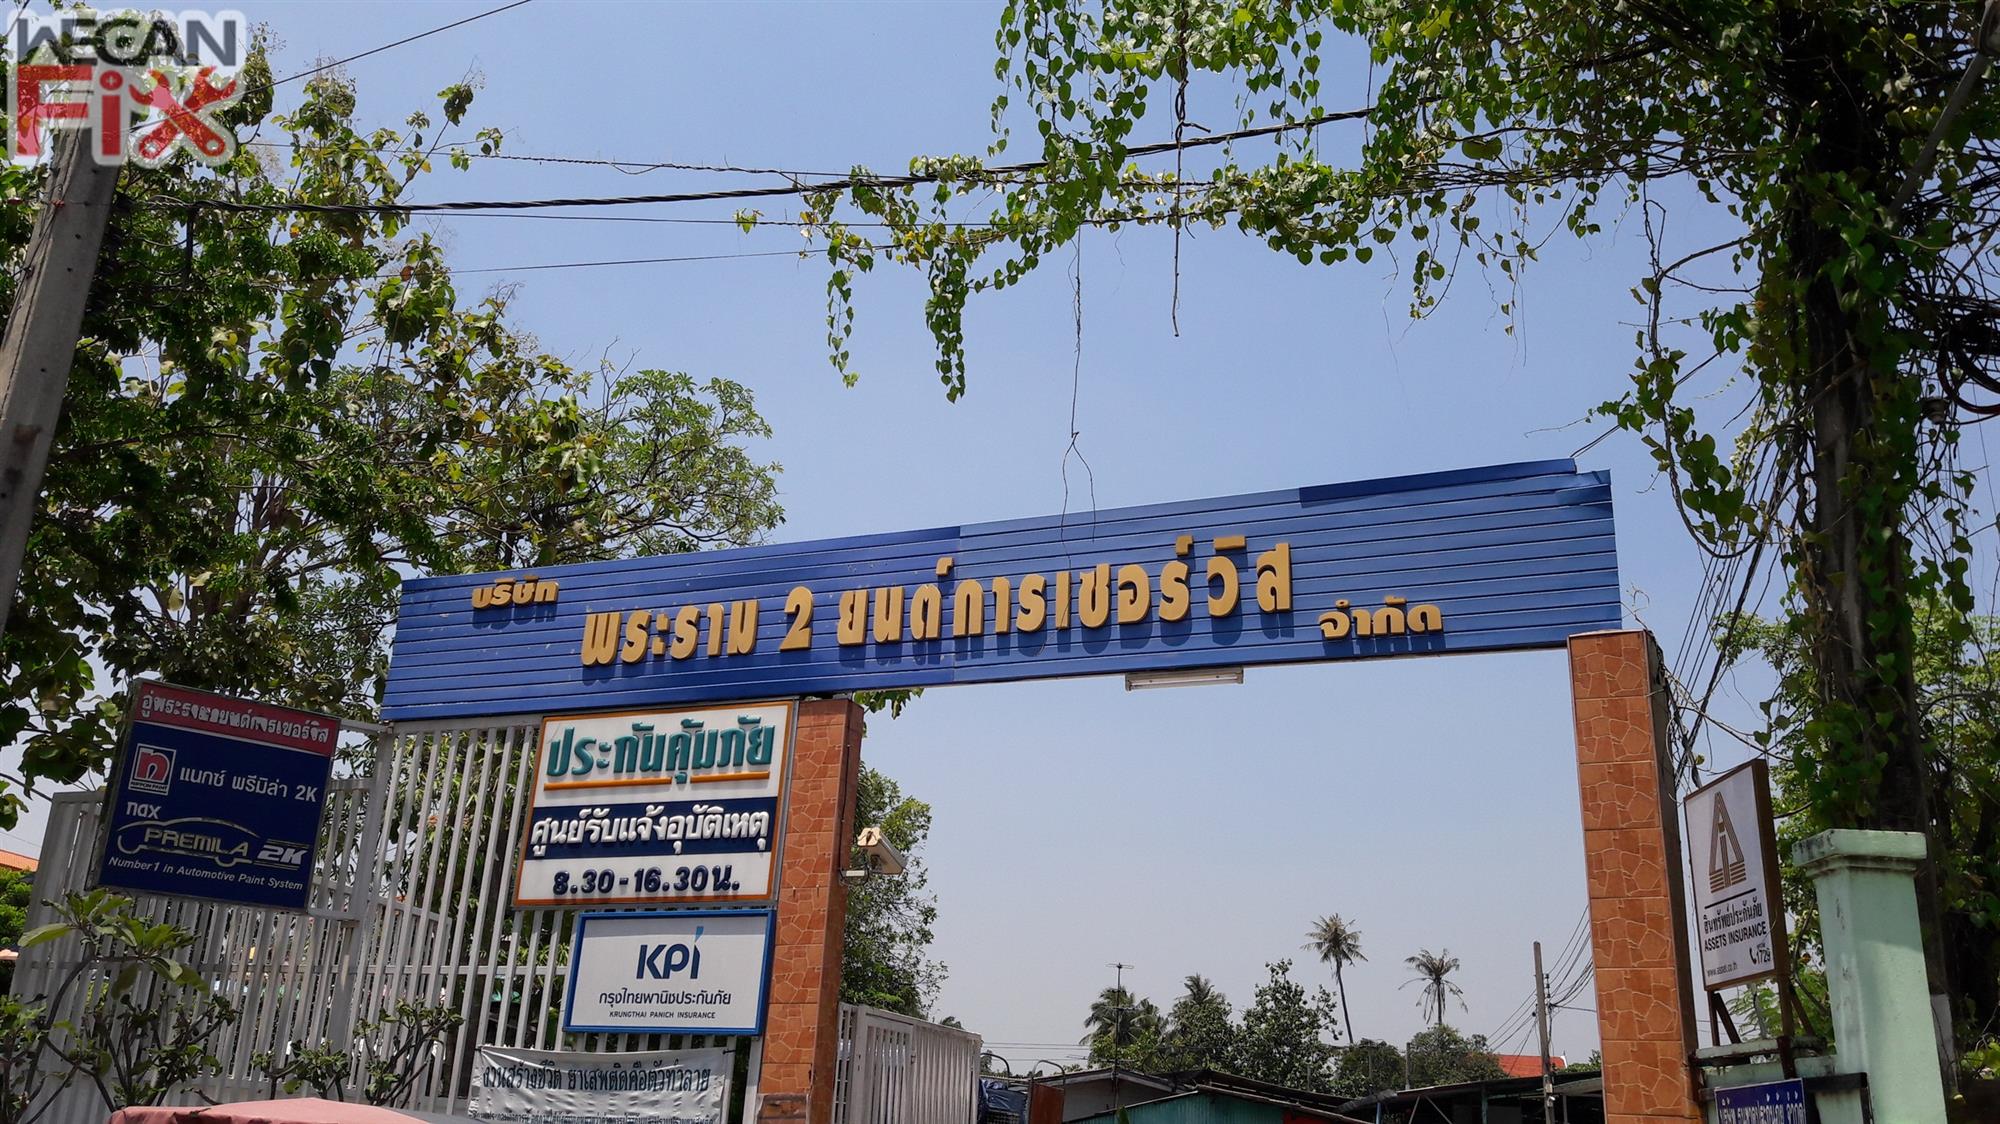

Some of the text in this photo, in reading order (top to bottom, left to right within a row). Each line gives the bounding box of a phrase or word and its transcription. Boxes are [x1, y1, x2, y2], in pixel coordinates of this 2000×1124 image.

[471, 575, 560, 609] บริษัท
[580, 599, 760, 667] พระราม
[779, 586, 813, 651] 2
[1317, 595, 1443, 640] จำกัด
[294, 784, 319, 802] 2K
[144, 827, 308, 865] PREMILA 2K
[530, 804, 770, 858] ศูนย์รับแจ้งอุบัติเหตุ
[163, 863, 173, 873] in
[176, 866, 236, 882] Automotive
[238, 873, 265, 886] Paint
[268, 877, 304, 891] System
[1704, 921, 1767, 953] ASSETS INSURANCE
[598, 987, 732, 1009] กรุงไทยพานิชประกันภัย
[608, 1010, 717, 1020] KRUNGTHAI PANICH INSURANCE
